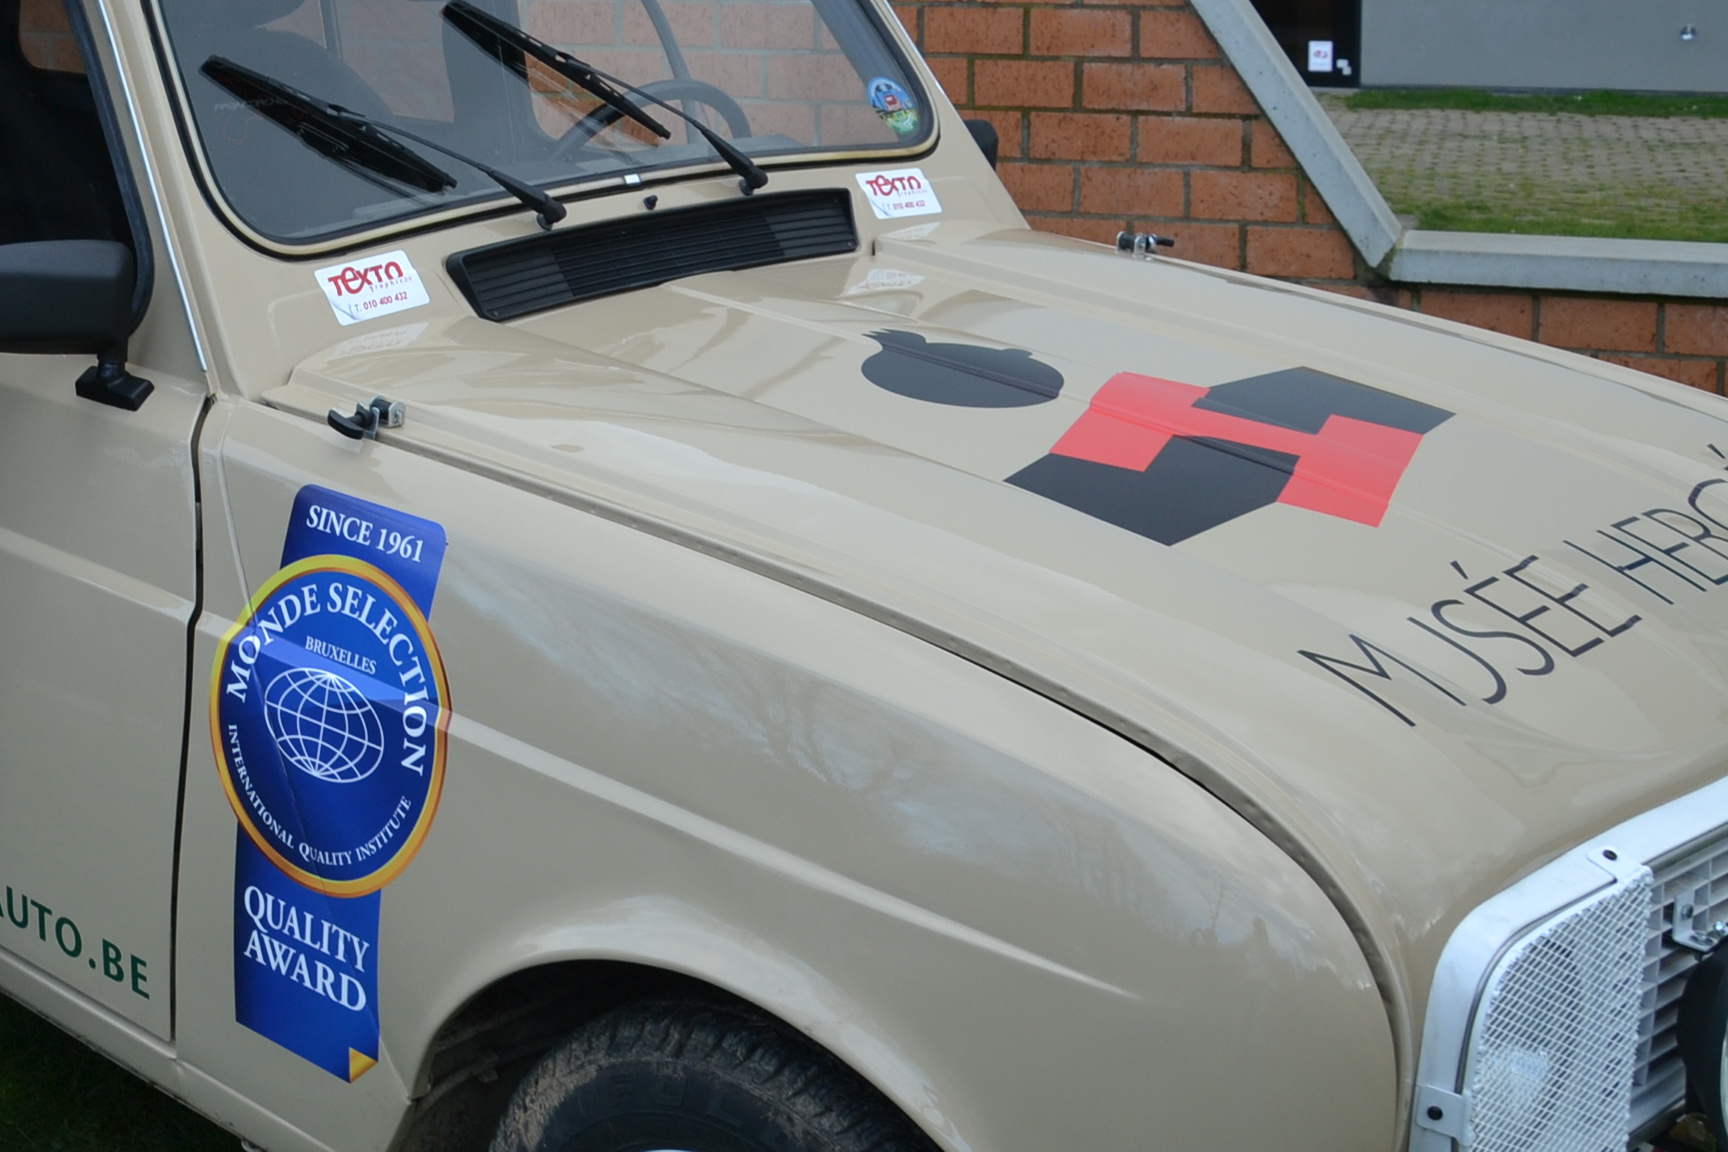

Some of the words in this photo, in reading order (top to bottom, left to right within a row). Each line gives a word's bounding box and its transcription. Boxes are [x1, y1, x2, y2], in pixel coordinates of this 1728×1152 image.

[363, 299, 378, 310] 010
[379, 295, 393, 306] 400
[394, 291, 408, 301] 432
[306, 504, 373, 546] SINCE
[376, 528, 423, 562] 1961
[226, 584, 321, 703] MONDE
[327, 582, 429, 776] SELECTION
[305, 635, 377, 675] BRUXELLES
[1296, 554, 1643, 727] MUSÉE
[228, 724, 294, 849] INTERNATIONAL
[298, 841, 352, 866] QUALITY
[356, 796, 412, 862] INSTITUTE
[243, 929, 367, 1011] AWARD
[244, 885, 370, 973] QUALITY
